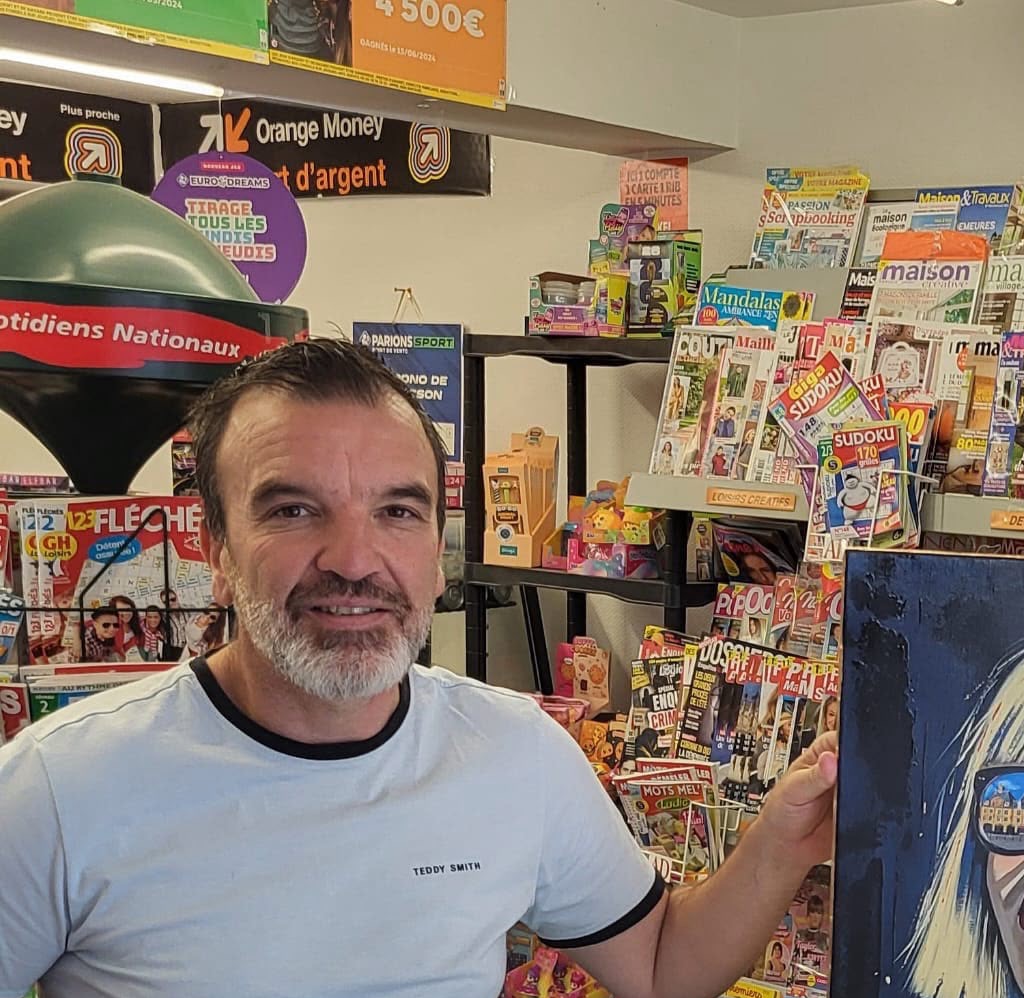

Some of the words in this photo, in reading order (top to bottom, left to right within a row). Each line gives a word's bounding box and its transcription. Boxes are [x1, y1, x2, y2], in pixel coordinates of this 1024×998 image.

[60, 104, 84, 117] Plus
[85, 109, 121, 122] proche
[256, 117, 319, 147] Orange
[323, 112, 384, 140] Money
[296, 159, 387, 195] d'argent
[645, 168, 680, 182] COMPTE
[632, 183, 659, 194] CARTE
[187, 201, 251, 215] TIRAGE
[188, 215, 231, 230] TOUS
[235, 217, 265, 231] LES
[873, 213, 907, 224] maison
[957, 220, 996, 231] EMEURES
[219, 245, 274, 259] EUDIS
[882, 262, 970, 281] maison
[703, 286, 781, 310] Mandalas
[111, 322, 241, 359] Nationaux
[371, 335, 413, 348] PARIONS
[414, 337, 454, 348] SPORT
[430, 375, 449, 386] DE
[787, 364, 827, 401] Giga
[789, 366, 843, 421] SUDOKU
[834, 427, 895, 448] SUDOKU
[956, 438, 973, 450] 80
[857, 446, 878, 460] 170
[711, 492, 745, 505] LOISIRS
[748, 493, 791, 507] CREATIFS
[94, 502, 205, 534] FLÉCHÉ
[40, 700, 50, 713] 2
[643, 783, 674, 797] MOTS
[413, 865, 445, 876] TEDDY
[450, 862, 481, 873] SMITH
